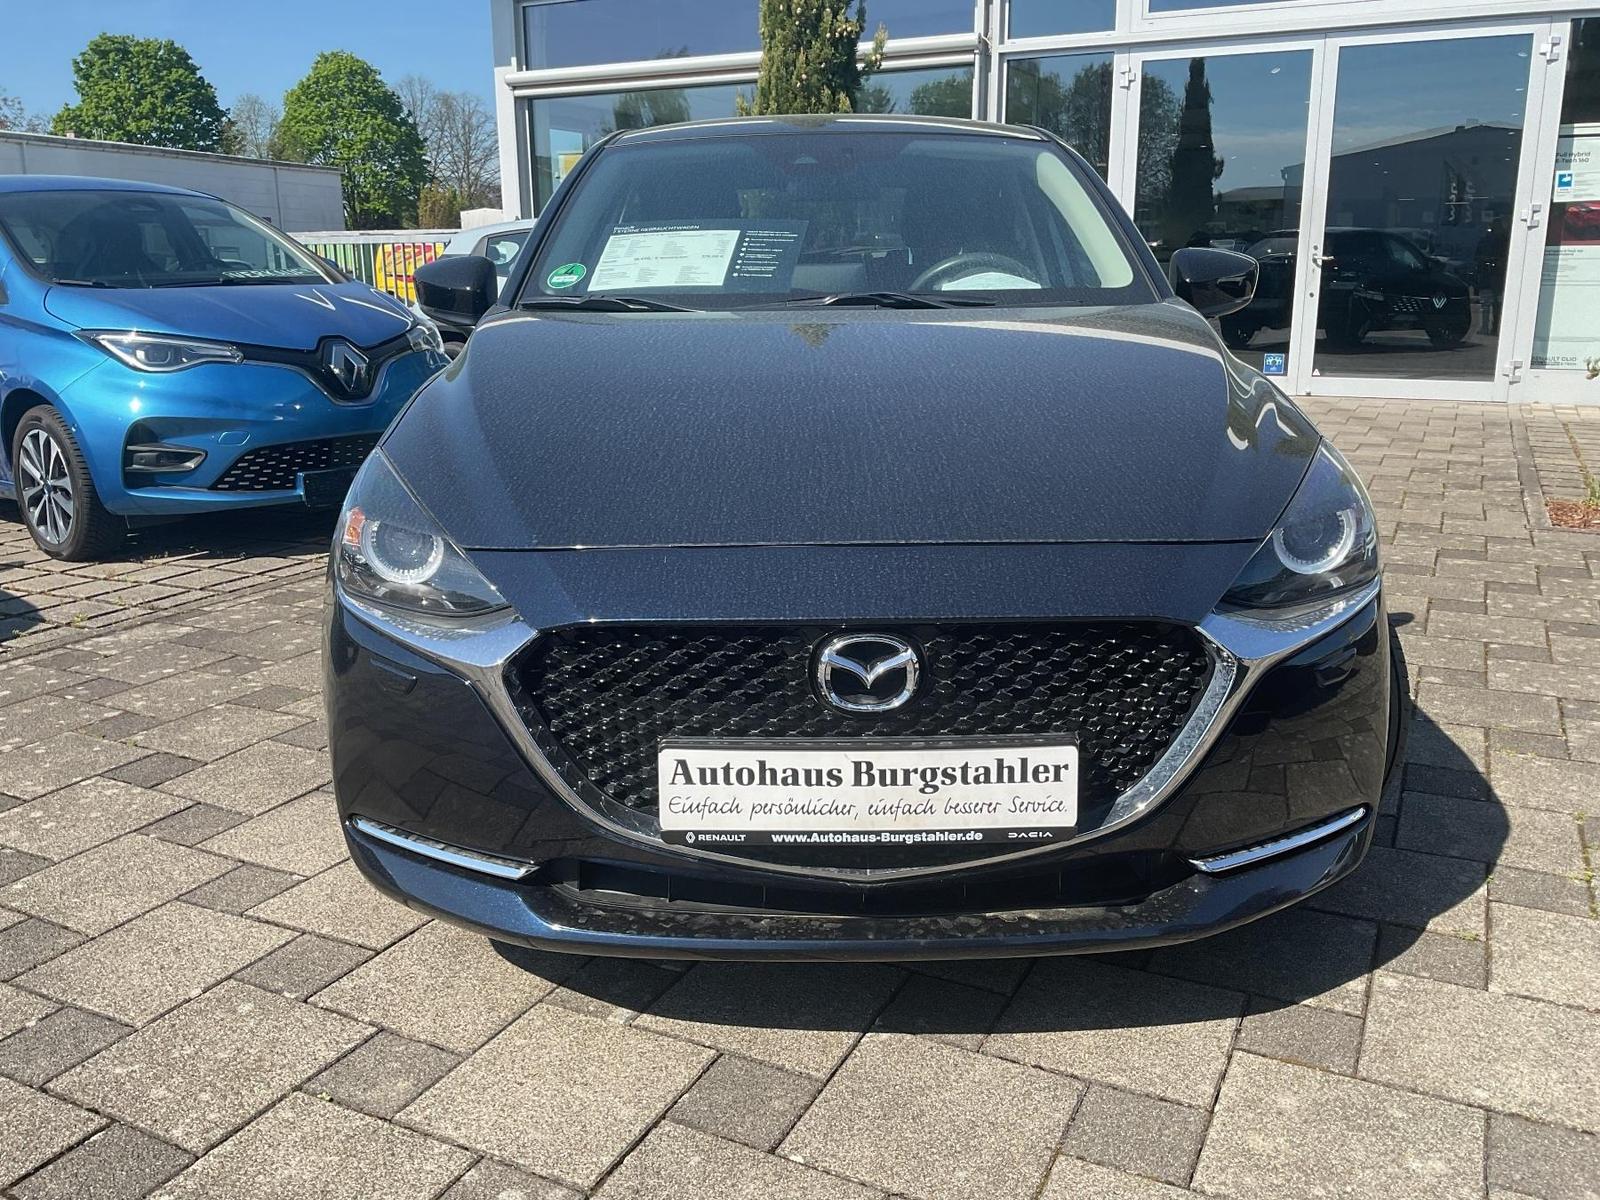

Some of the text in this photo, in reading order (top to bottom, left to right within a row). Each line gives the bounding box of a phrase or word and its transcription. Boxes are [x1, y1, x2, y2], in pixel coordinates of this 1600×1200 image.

[670, 758, 1070, 795] Autohaus Burgstahler
[668, 795, 1068, 821] Einfach persönlicher, einfach besserer Service.
[697, 830, 1053, 844] RENAULT www.Autohaus-Burgstahler.de DACIA
